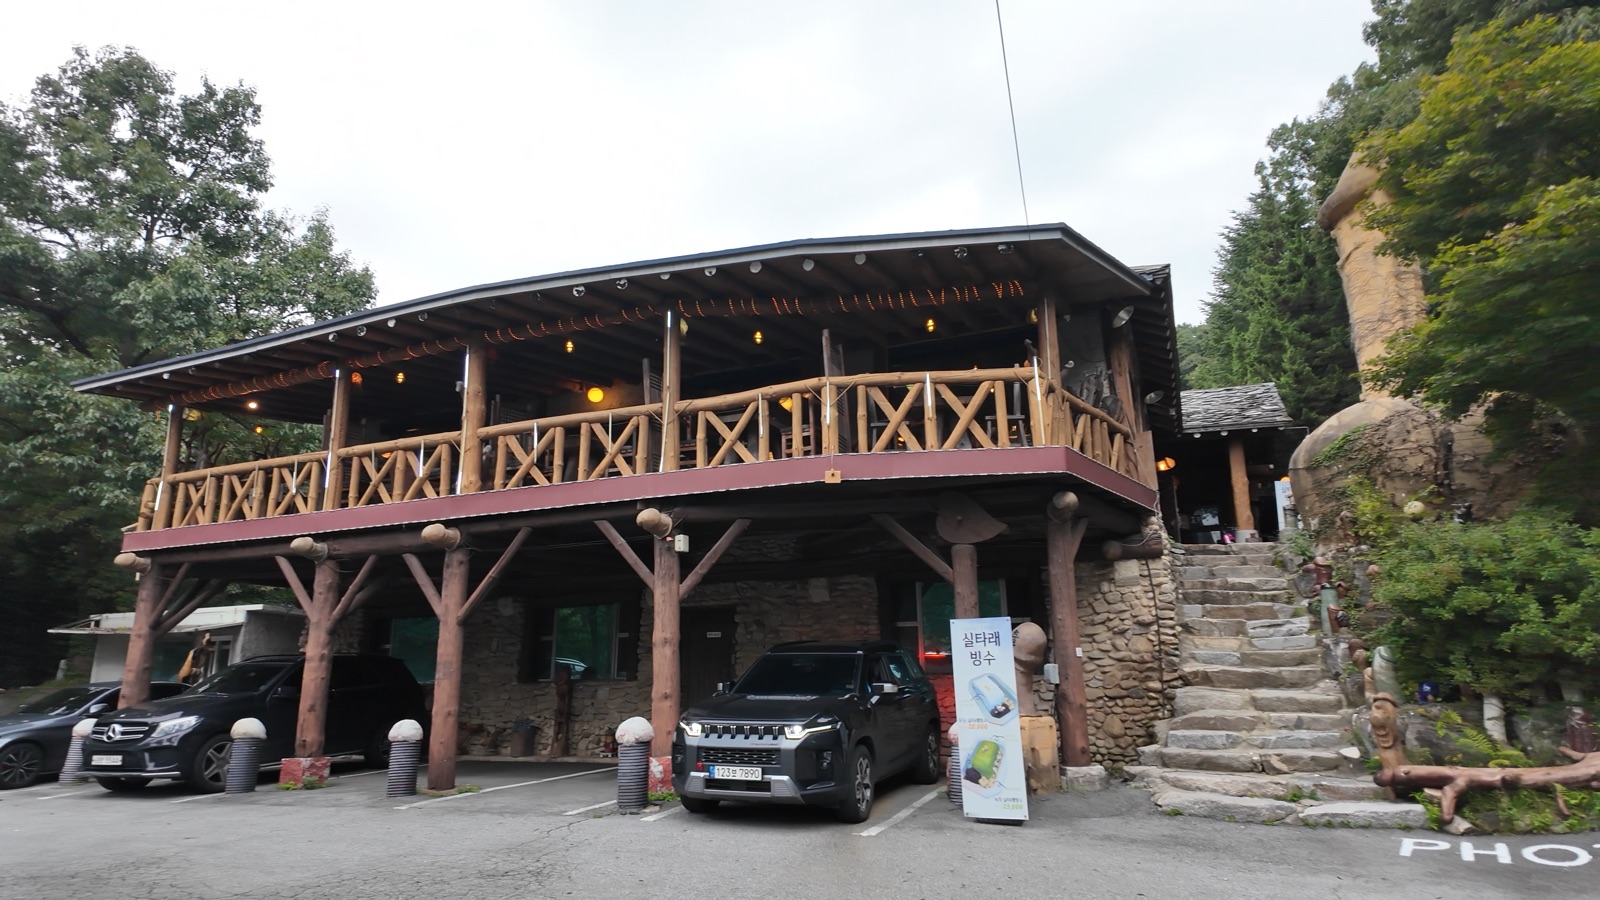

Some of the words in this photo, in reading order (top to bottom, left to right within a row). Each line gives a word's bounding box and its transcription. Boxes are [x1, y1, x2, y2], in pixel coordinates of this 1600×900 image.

[962, 631, 1001, 648] 실타래
[970, 650, 996, 667] 빙수
[739, 768, 760, 779] 7890
[1399, 837, 1600, 868] PHO
